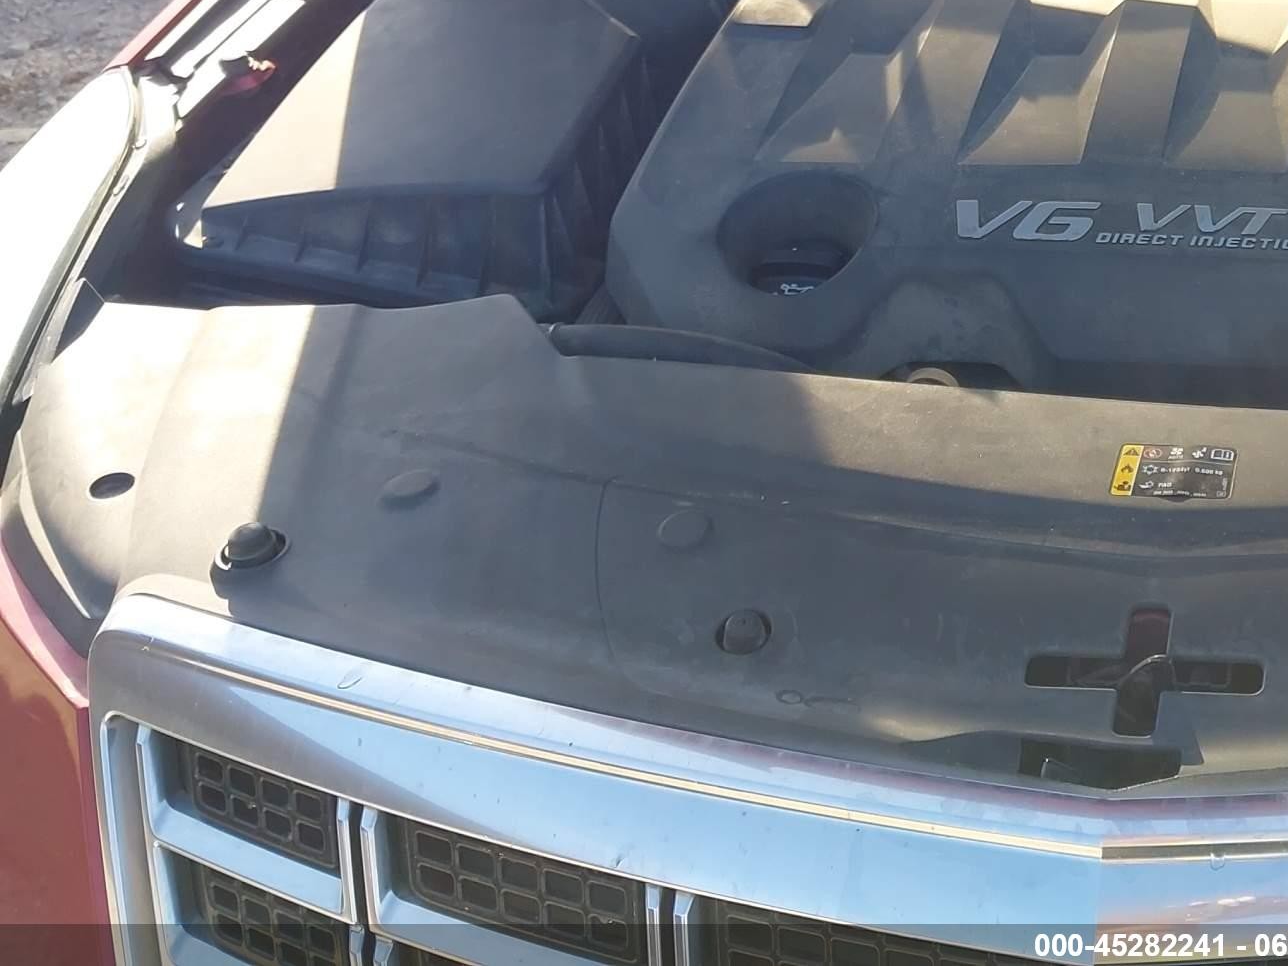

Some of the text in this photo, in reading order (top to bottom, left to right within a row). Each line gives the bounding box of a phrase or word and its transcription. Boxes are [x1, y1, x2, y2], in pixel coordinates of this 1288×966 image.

[956, 199, 1288, 242] V6 VVT
[1095, 231, 1184, 247] DIRECT
